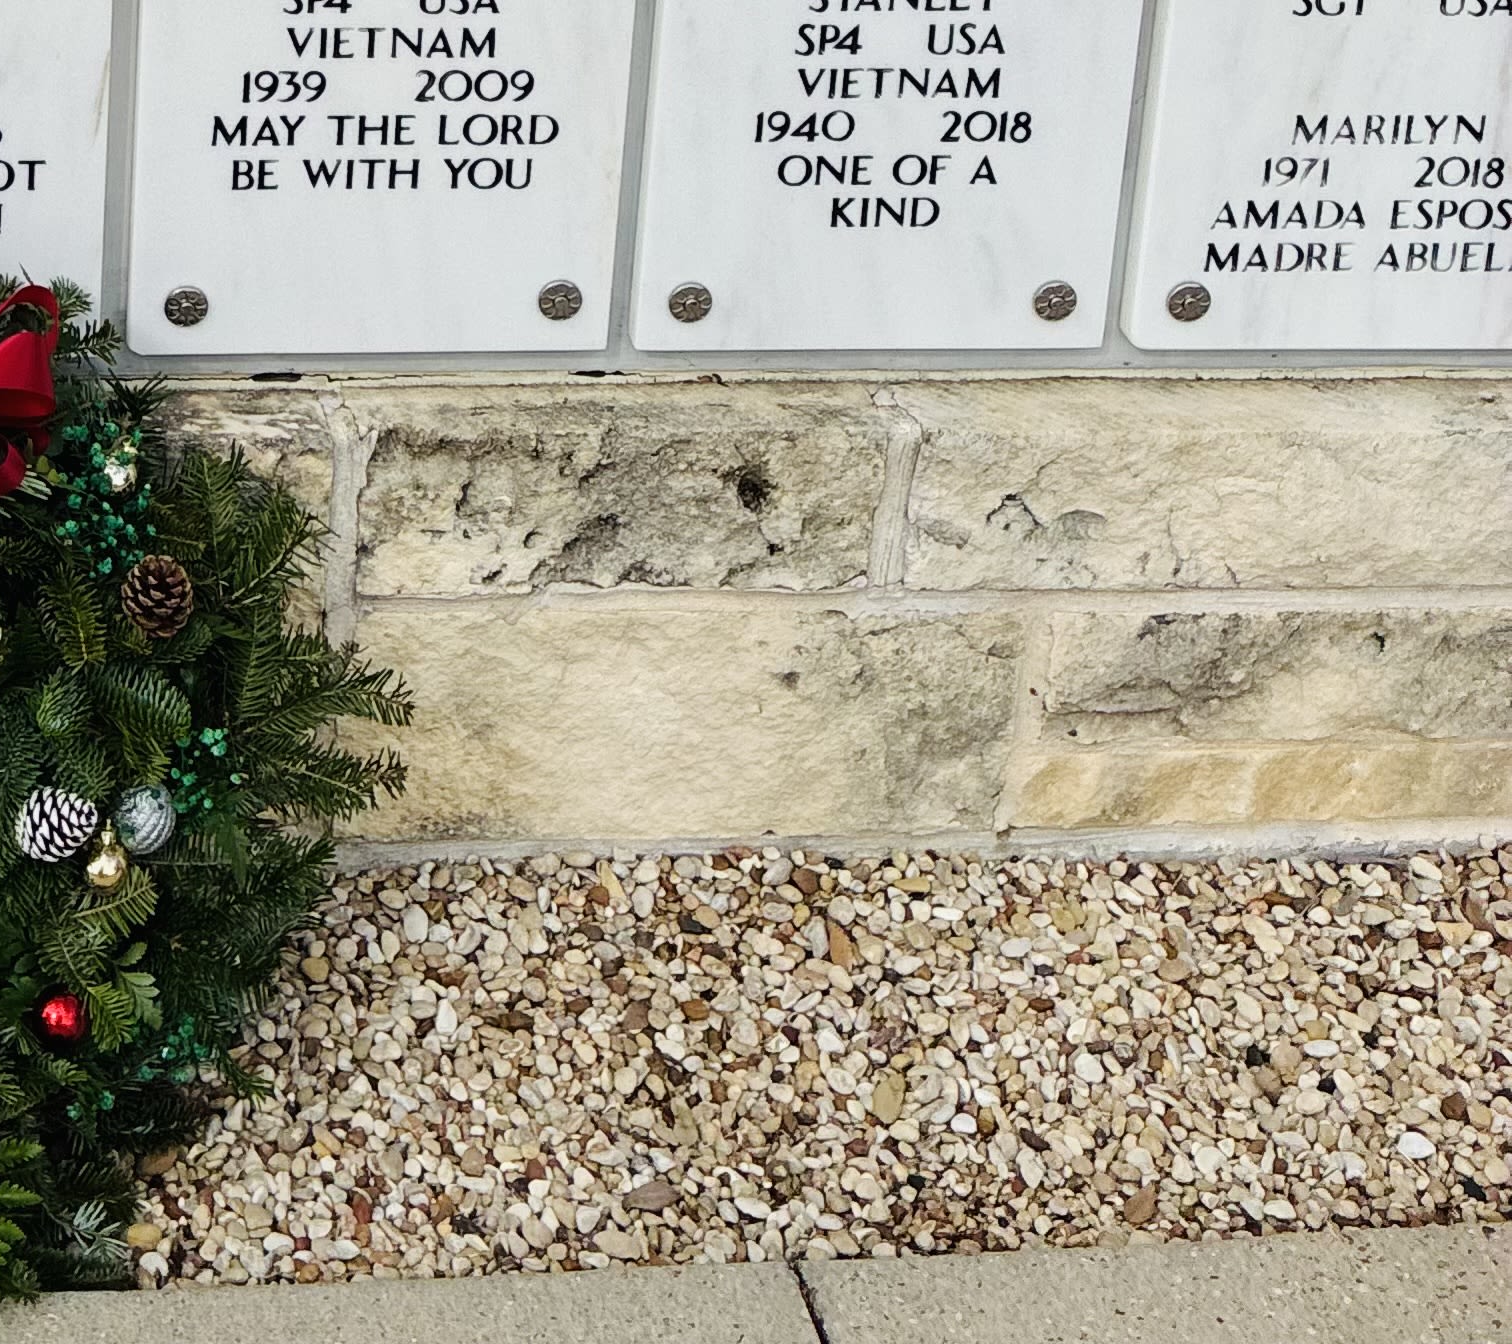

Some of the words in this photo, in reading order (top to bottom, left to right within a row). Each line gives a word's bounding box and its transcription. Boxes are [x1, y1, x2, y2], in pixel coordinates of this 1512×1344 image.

[793, 22, 864, 58] SP4
[926, 21, 1006, 57] USA
[241, 69, 328, 104] 1939
[413, 68, 536, 104] 2009
[1291, 113, 1487, 146] MARILYN
[230, 158, 279, 192] BE
[301, 157, 421, 191] WITH
[443, 156, 534, 191] YOU
[776, 153, 875, 188] ONE
[891, 153, 953, 187] OF
[968, 154, 998, 186] A
[1261, 155, 1331, 188] 1971
[1413, 155, 1506, 190] 2018
